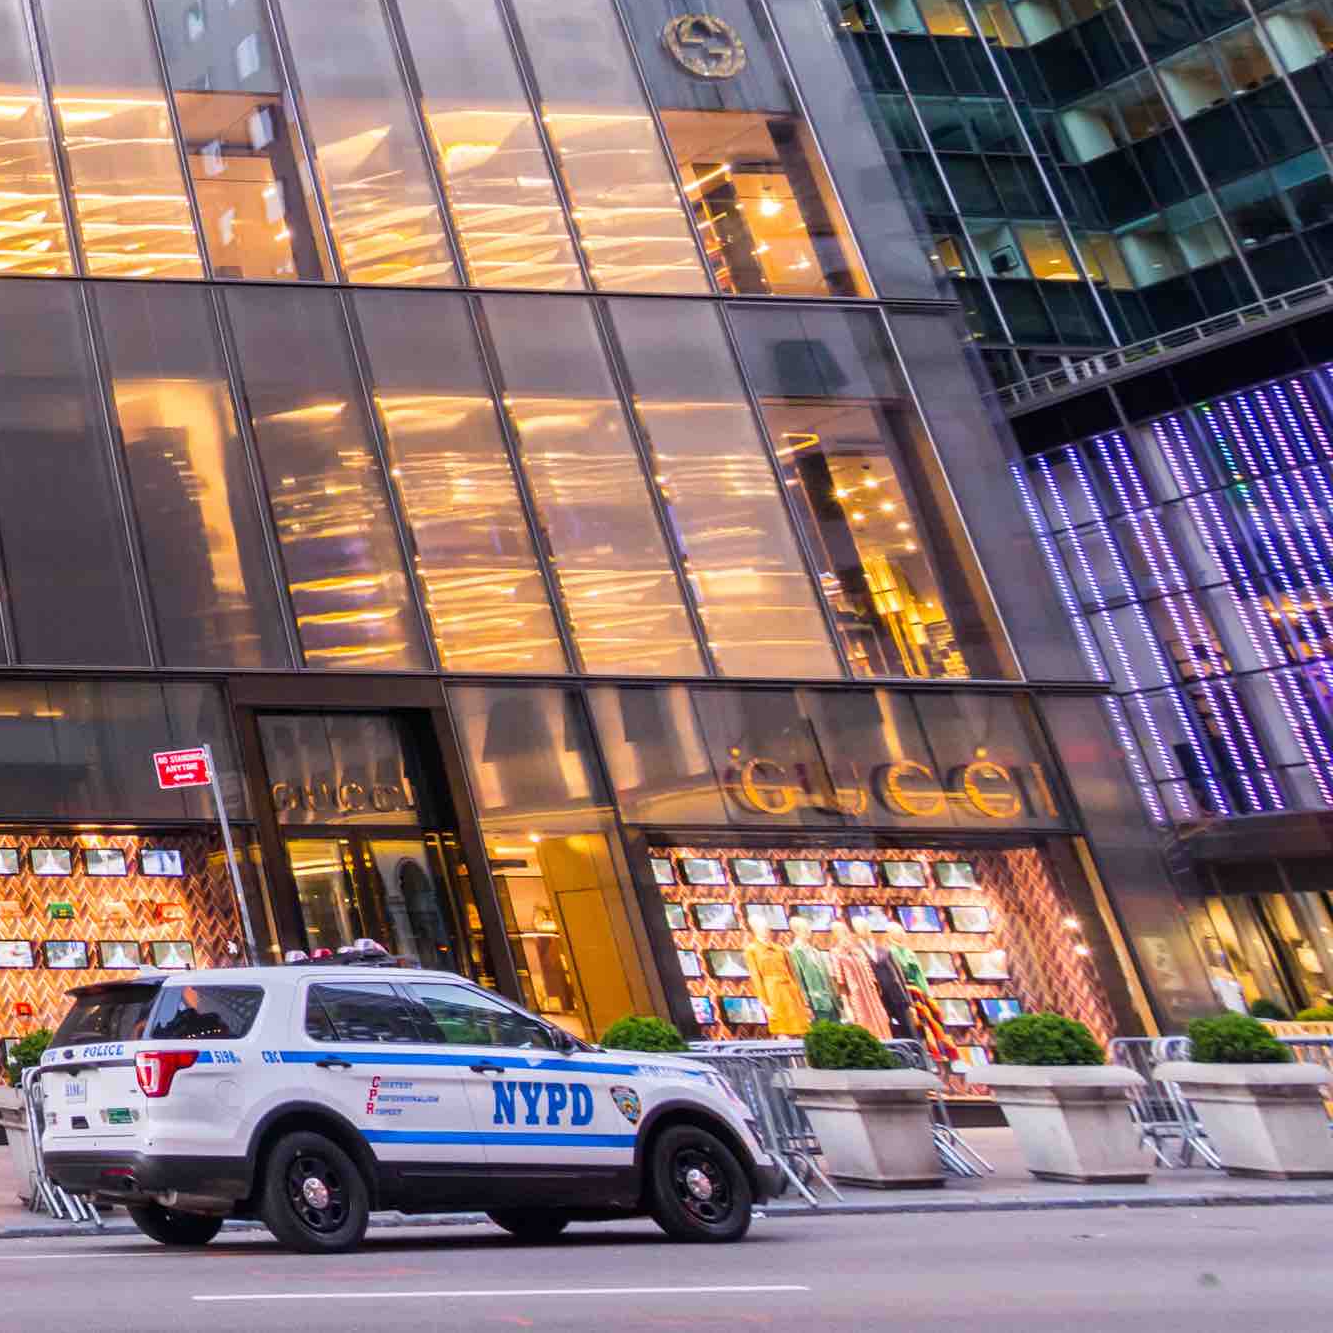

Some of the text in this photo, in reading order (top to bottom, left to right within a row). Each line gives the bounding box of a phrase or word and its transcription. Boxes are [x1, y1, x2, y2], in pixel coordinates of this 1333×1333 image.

[737, 757, 1059, 818] GUCCI
[83, 1044, 125, 1058] POLICE
[492, 1081, 595, 1126] NYPD
